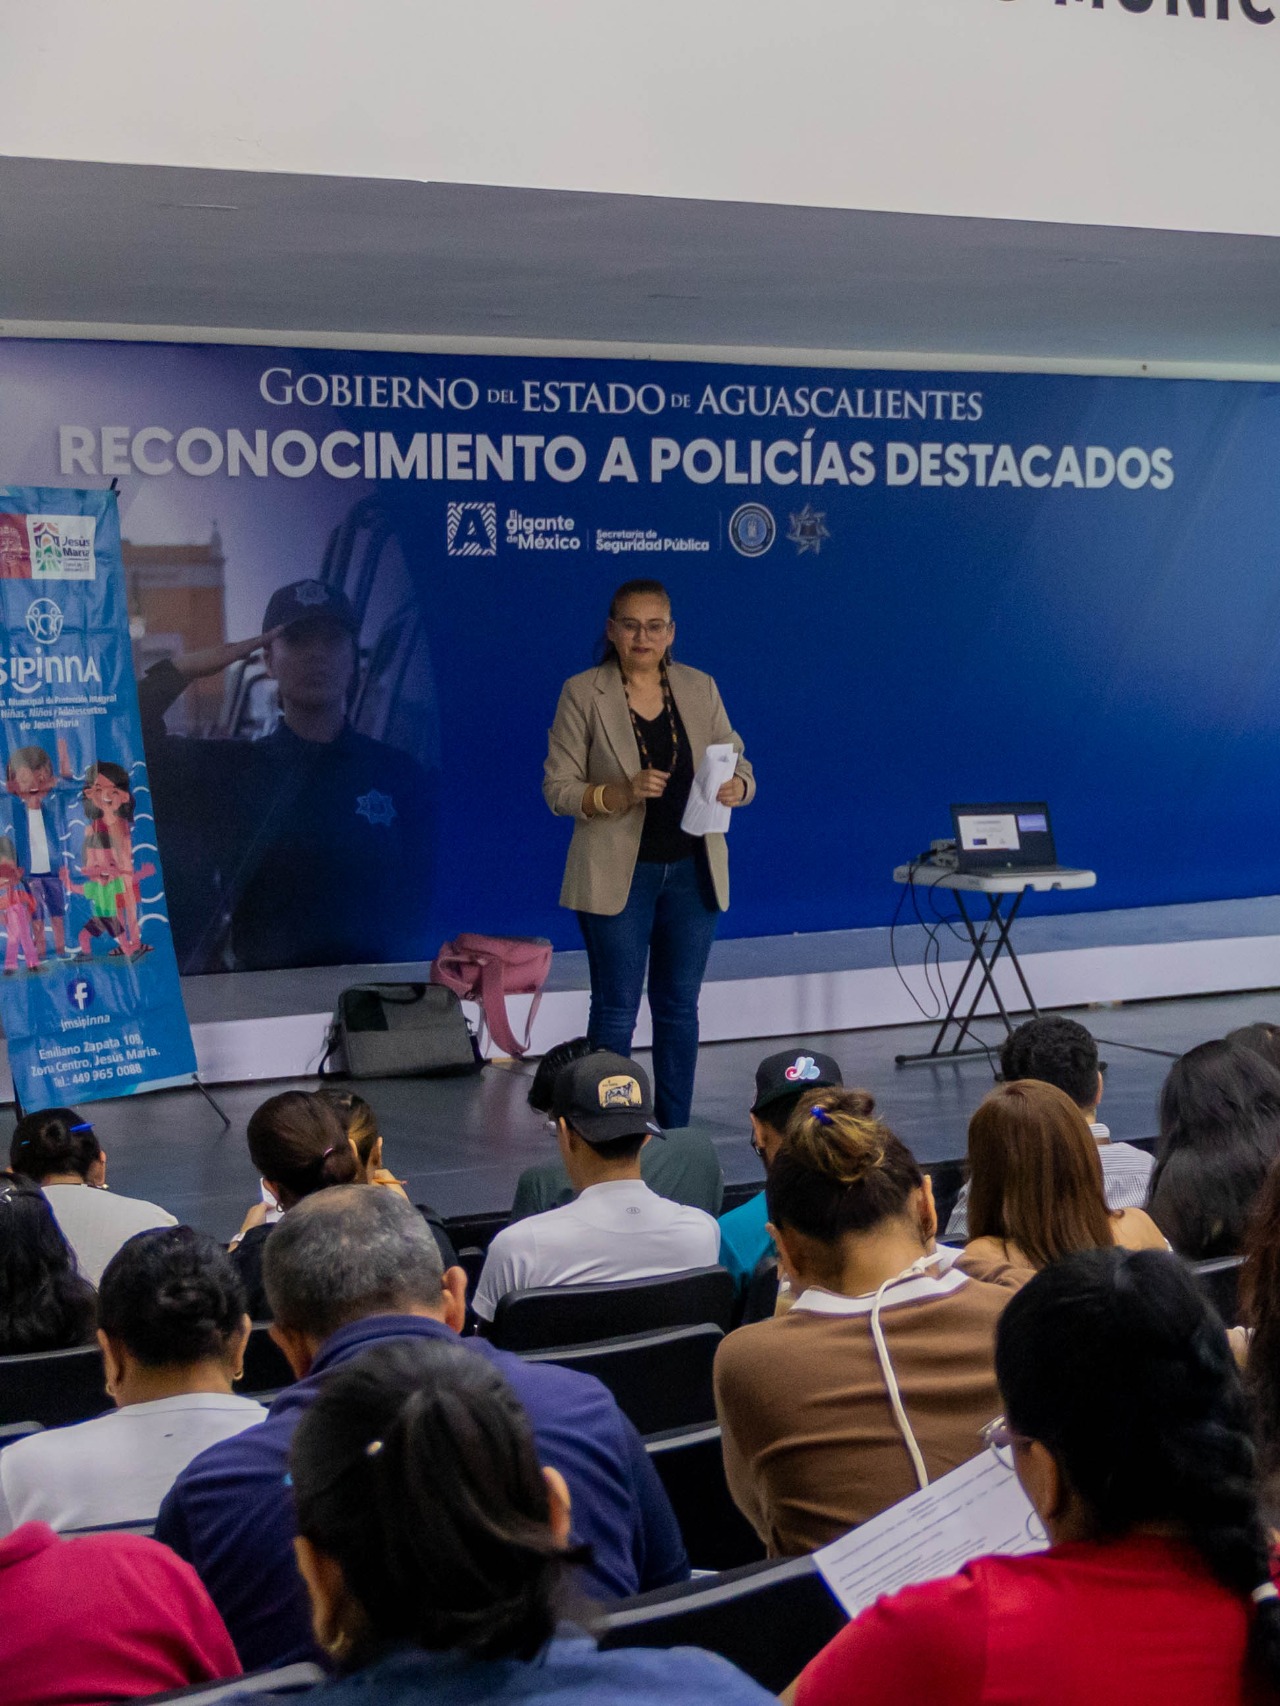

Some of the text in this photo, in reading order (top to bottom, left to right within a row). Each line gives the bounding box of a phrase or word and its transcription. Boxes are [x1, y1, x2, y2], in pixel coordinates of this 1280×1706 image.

[259, 367, 983, 421] GOBIERNO DEL ESTADO DE AGUASCALIENTES
[59, 425, 1174, 490] RECONOCIMIENTO A POLICÍAS DESTACADOS
[505, 514, 575, 533] gigante
[506, 531, 581, 550] de México
[645, 529, 658, 539] de
[596, 537, 710, 554] Seguridad Pública
[20, 719, 31, 730] de
[61, 1013, 111, 1033] jmsipinna
[38, 1044, 80, 1060] Emiliano
[83, 1036, 120, 1054] Zapata
[56, 1057, 92, 1072] Centro,
[72, 1070, 91, 1085] 449
[116, 1062, 143, 1077] 0088
